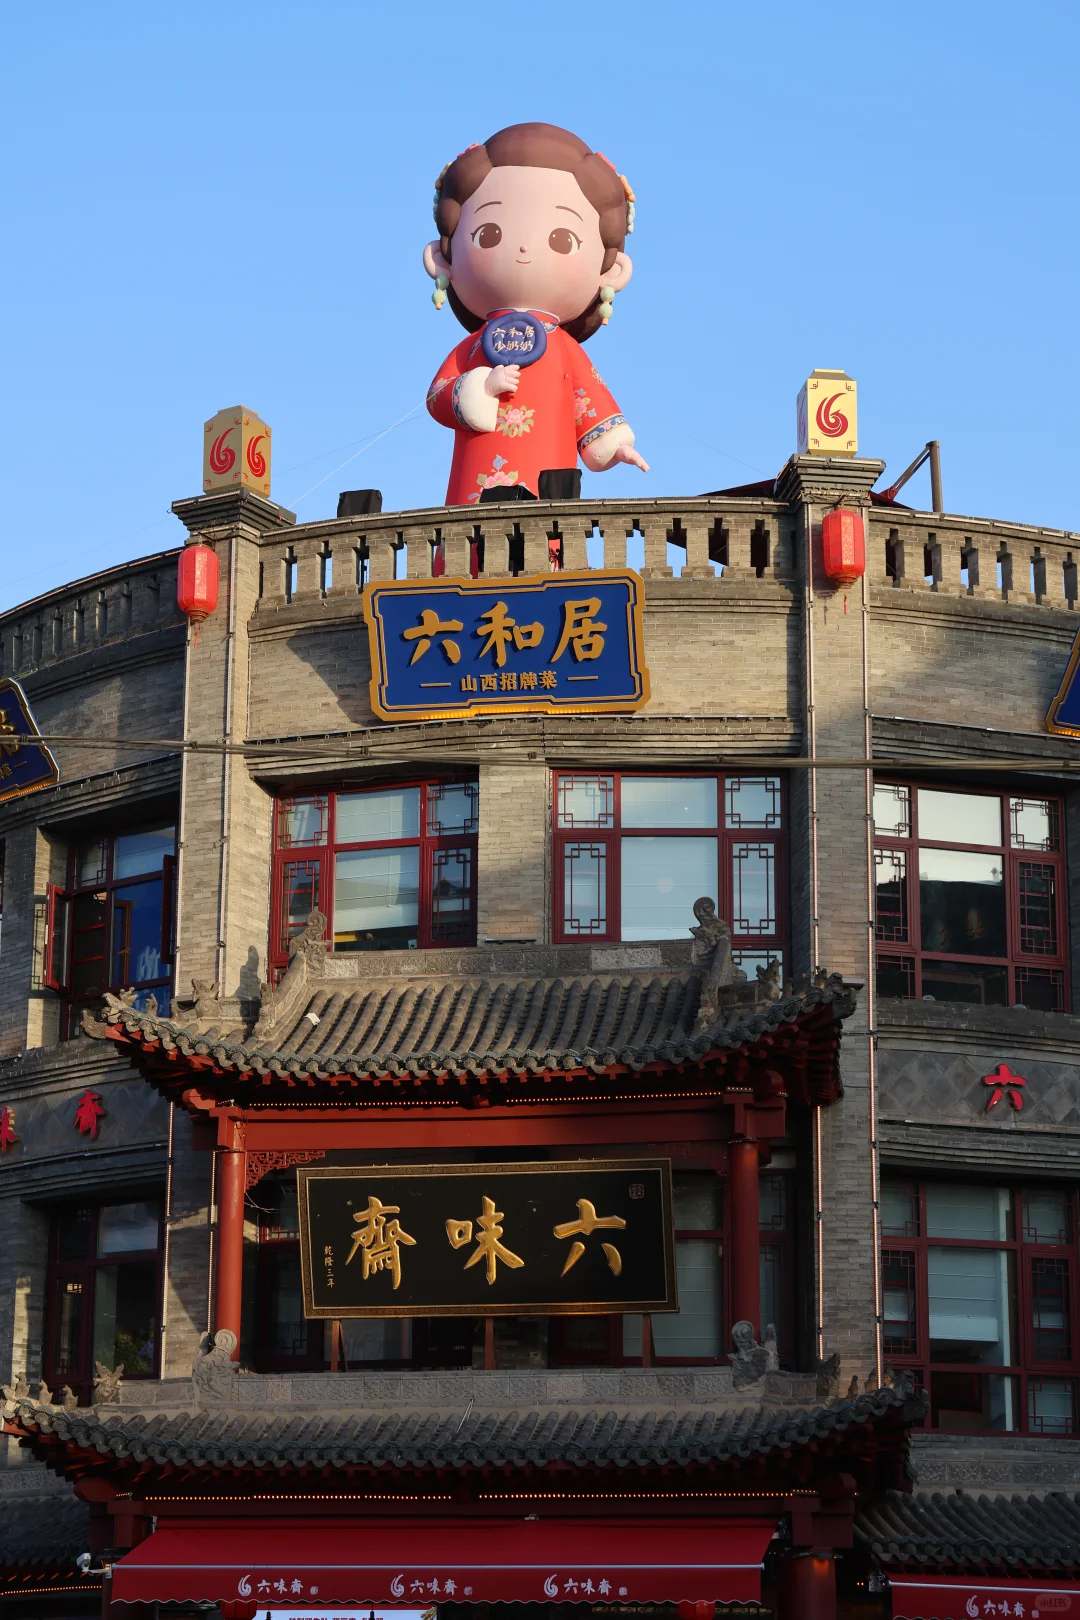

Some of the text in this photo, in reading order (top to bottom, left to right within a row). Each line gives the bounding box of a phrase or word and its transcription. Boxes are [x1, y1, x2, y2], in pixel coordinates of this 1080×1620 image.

[492, 325, 535, 339] 六和居
[492, 340, 534, 353] 少奶奶
[403, 597, 608, 668] 六和居
[460, 670, 558, 692] 山西招牌菜
[984, 1063, 1027, 1101] 六
[324, 1245, 335, 1289] 乾隆三年
